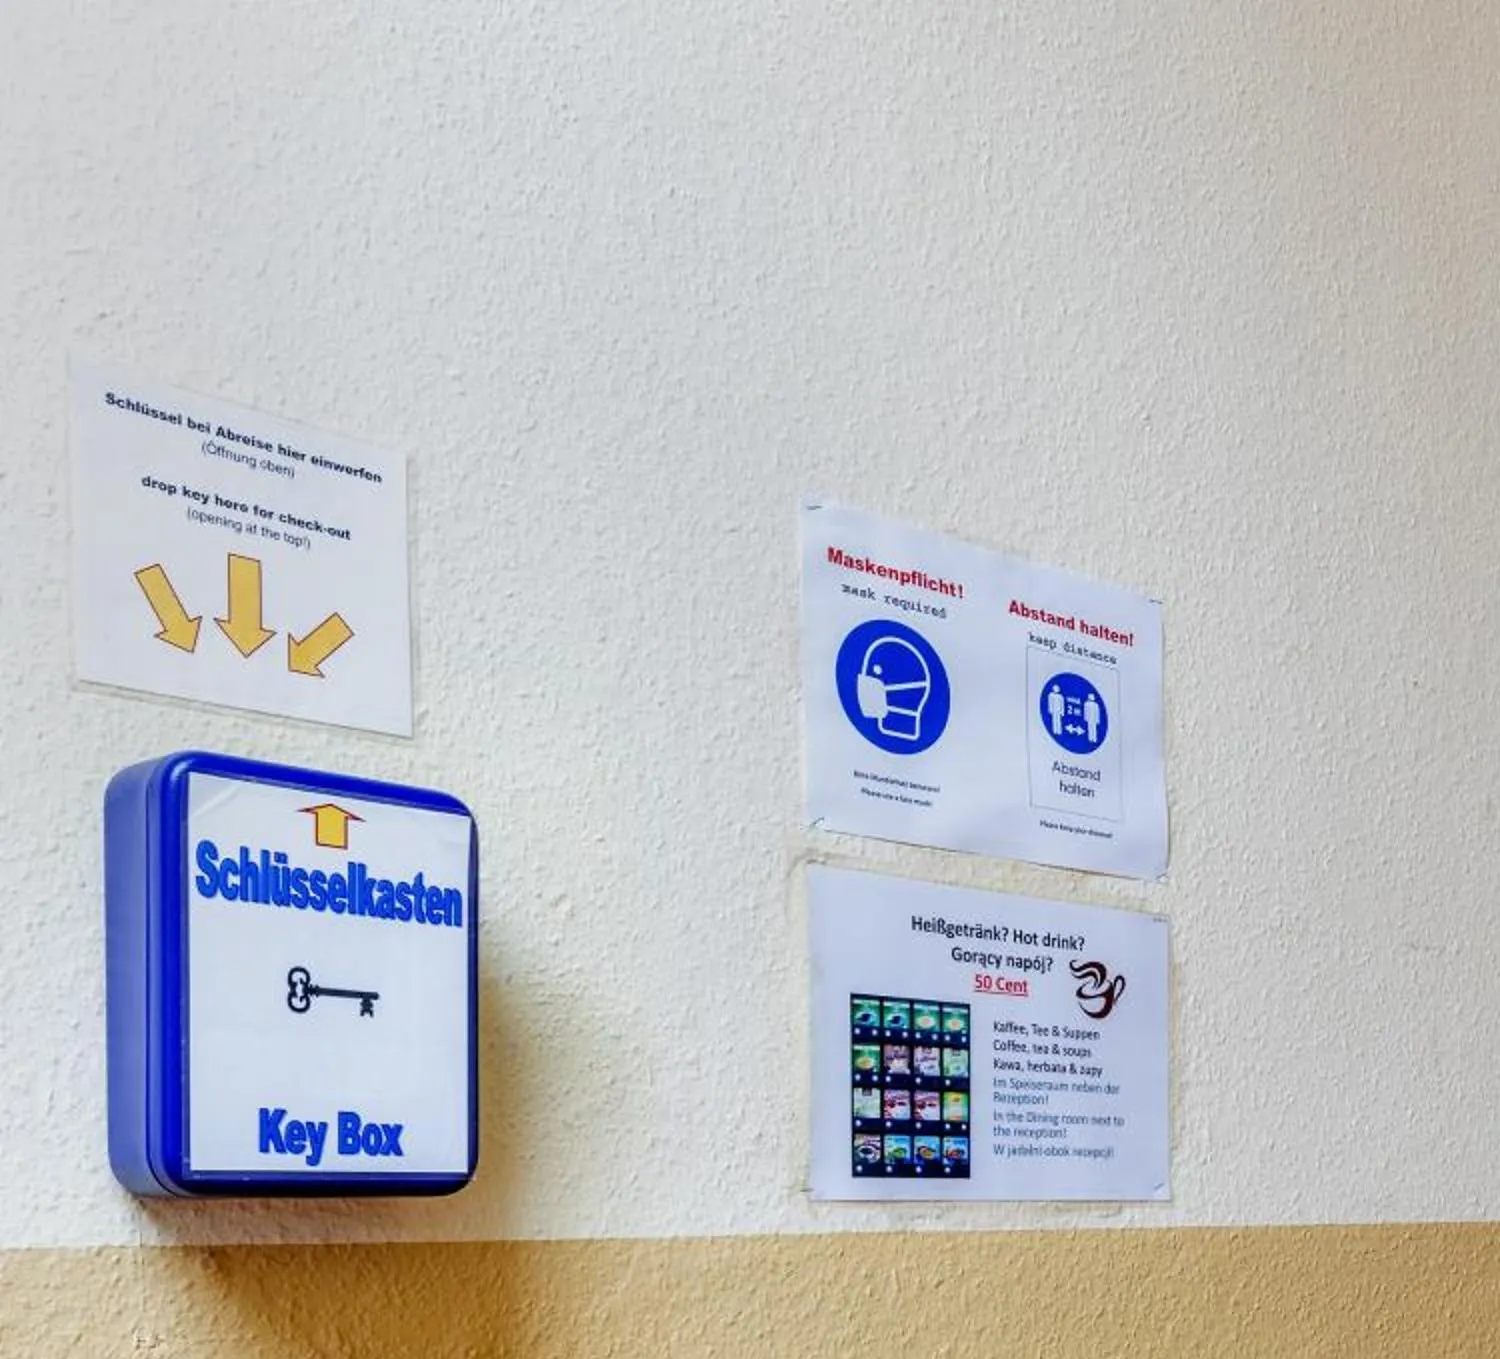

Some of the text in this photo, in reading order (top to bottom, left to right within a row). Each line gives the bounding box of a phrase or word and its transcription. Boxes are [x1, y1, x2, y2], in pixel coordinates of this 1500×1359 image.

[105, 392, 382, 484] Schlüssel bei Abreise hier einwerfen
[142, 476, 351, 540] drop key here for check-out
[245, 524, 257, 535] at
[261, 526, 281, 540] the
[827, 546, 963, 599] Maskenpflicht!
[841, 584, 947, 619] mask required
[1009, 599, 1134, 647] Abstand halten!
[1052, 760, 1101, 782] Abstand
[1059, 779, 1095, 798] halten
[195, 839, 463, 927] Schlüsselkasten
[911, 915, 1085, 951] Heißgetränk? Hot drink?
[951, 947, 1053, 974] Gorący napój?
[975, 973, 1028, 993] 50 Cent
[993, 1021, 1100, 1041] Kaffee, Tee & Suppen
[993, 1039, 1030, 1055] Coffee,
[1033, 1043, 1049, 1055] tea
[1051, 1043, 1060, 1056] &
[1069, 1063, 1077, 1075] &
[258, 1106, 403, 1167] Key Box
